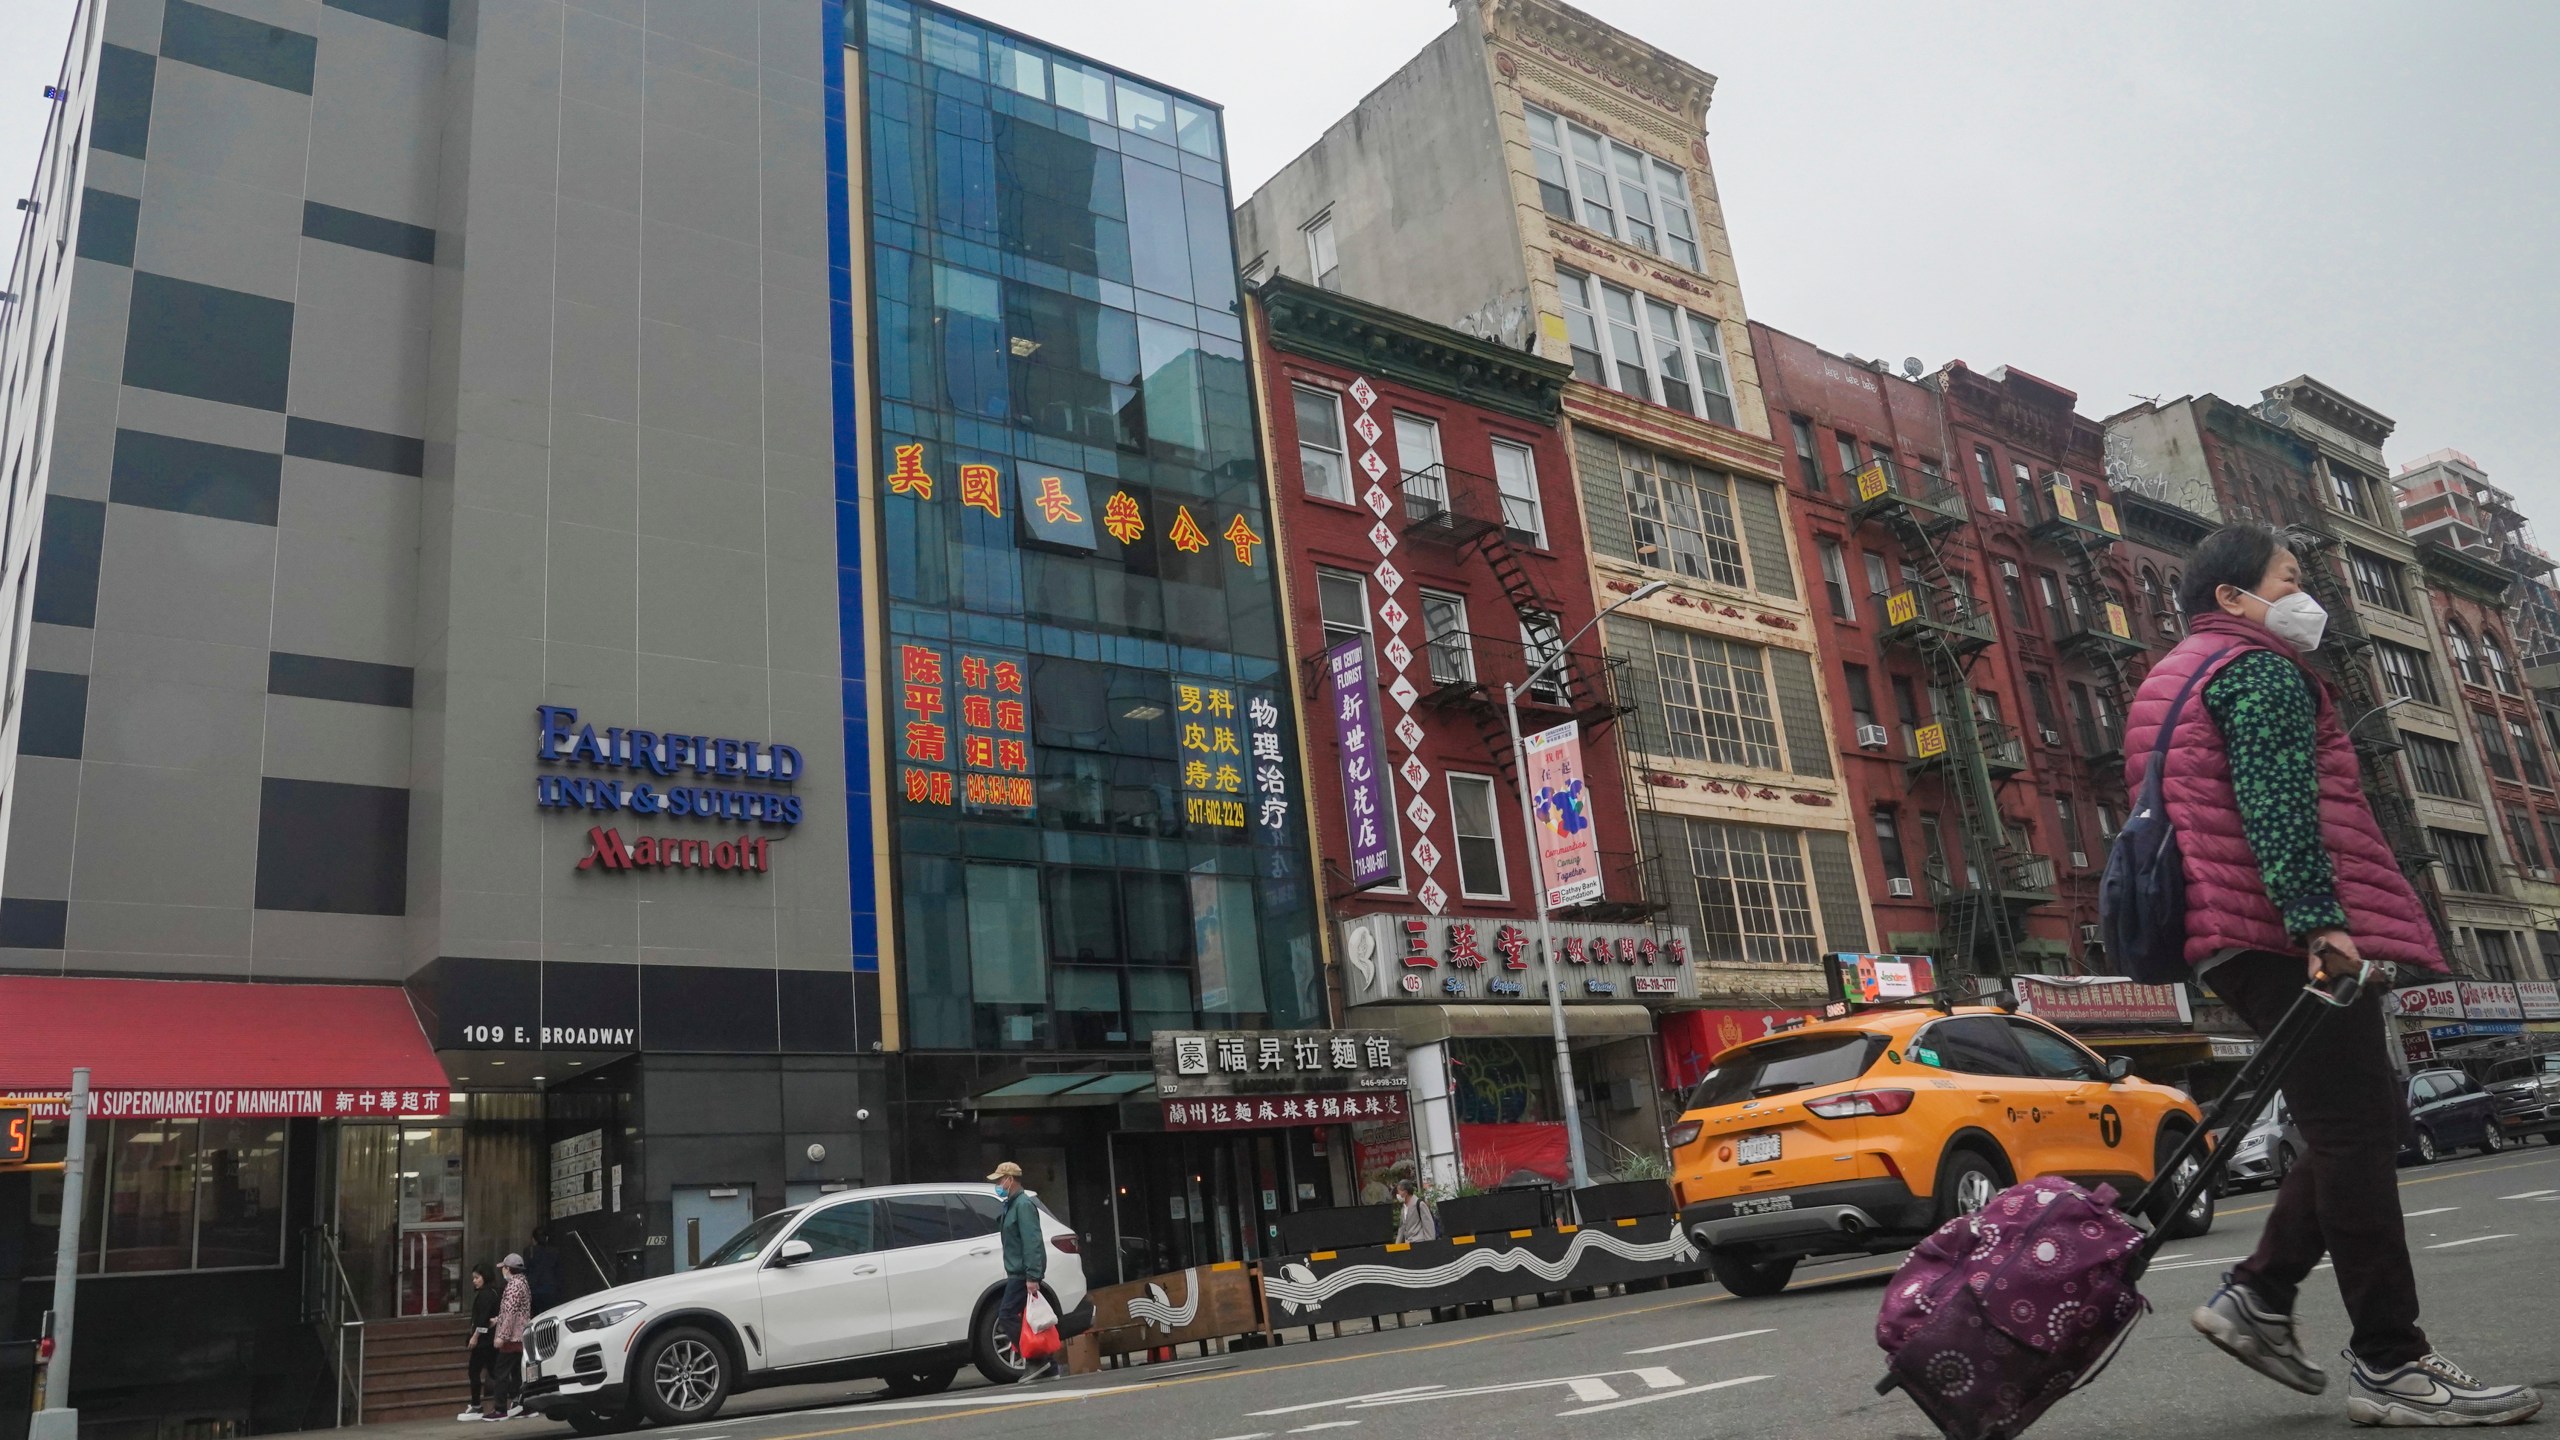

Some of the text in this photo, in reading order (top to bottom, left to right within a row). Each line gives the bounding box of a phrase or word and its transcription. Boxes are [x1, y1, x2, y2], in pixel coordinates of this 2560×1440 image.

[1861, 472, 1882, 497] 福
[888, 443, 1262, 567] 美國長樂公會
[1890, 597, 1914, 623] 州
[961, 655, 1023, 694] 针灸
[1337, 665, 1363, 690] FLORIST
[963, 695, 1025, 732] 痛症
[1178, 684, 1235, 719] 男科
[536, 704, 804, 782] FAIRFIELD
[965, 734, 1027, 772] 妇科
[1183, 722, 1239, 755] 皮肤
[1920, 726, 1942, 756] 超
[1185, 759, 1241, 792] 痔疮
[1250, 697, 1288, 829] 物理治疗
[1340, 691, 1377, 848] 新世紀花店
[536, 775, 803, 825] INN & SUITES
[905, 768, 951, 805] 诊所
[966, 773, 1033, 807] 646-354-8828
[1187, 798, 1245, 827] 917-602-2229
[576, 825, 769, 873] Marriott
[1557, 854, 1582, 869] Coming
[1556, 867, 1587, 884] Together
[1560, 879, 1597, 897] Cathay Bank
[1561, 888, 1595, 902] Foundation
[1404, 920, 1530, 970] 三蒸堂
[1405, 976, 1420, 991] 105
[1446, 975, 1468, 994] Spa
[2427, 986, 2455, 1006] Bus
[2036, 1007, 2056, 1018] China
[2090, 1008, 2102, 1018] Fine
[2103, 1008, 2125, 1018] Ceramic
[2125, 1008, 2150, 1018] Furniture
[463, 1025, 635, 1044] 109 E. BROADWAY
[102, 1090, 213, 1115] SUPERMARKET
[215, 1090, 234, 1114] OF
[237, 1090, 322, 1113] MANHATTAN
[335, 1090, 440, 1113] 新中華超市
[1163, 1085, 1178, 1093] 107
[10, 1118, 25, 1152] 5
[2104, 1113, 2117, 1143] T
[648, 1236, 666, 1245] 109
